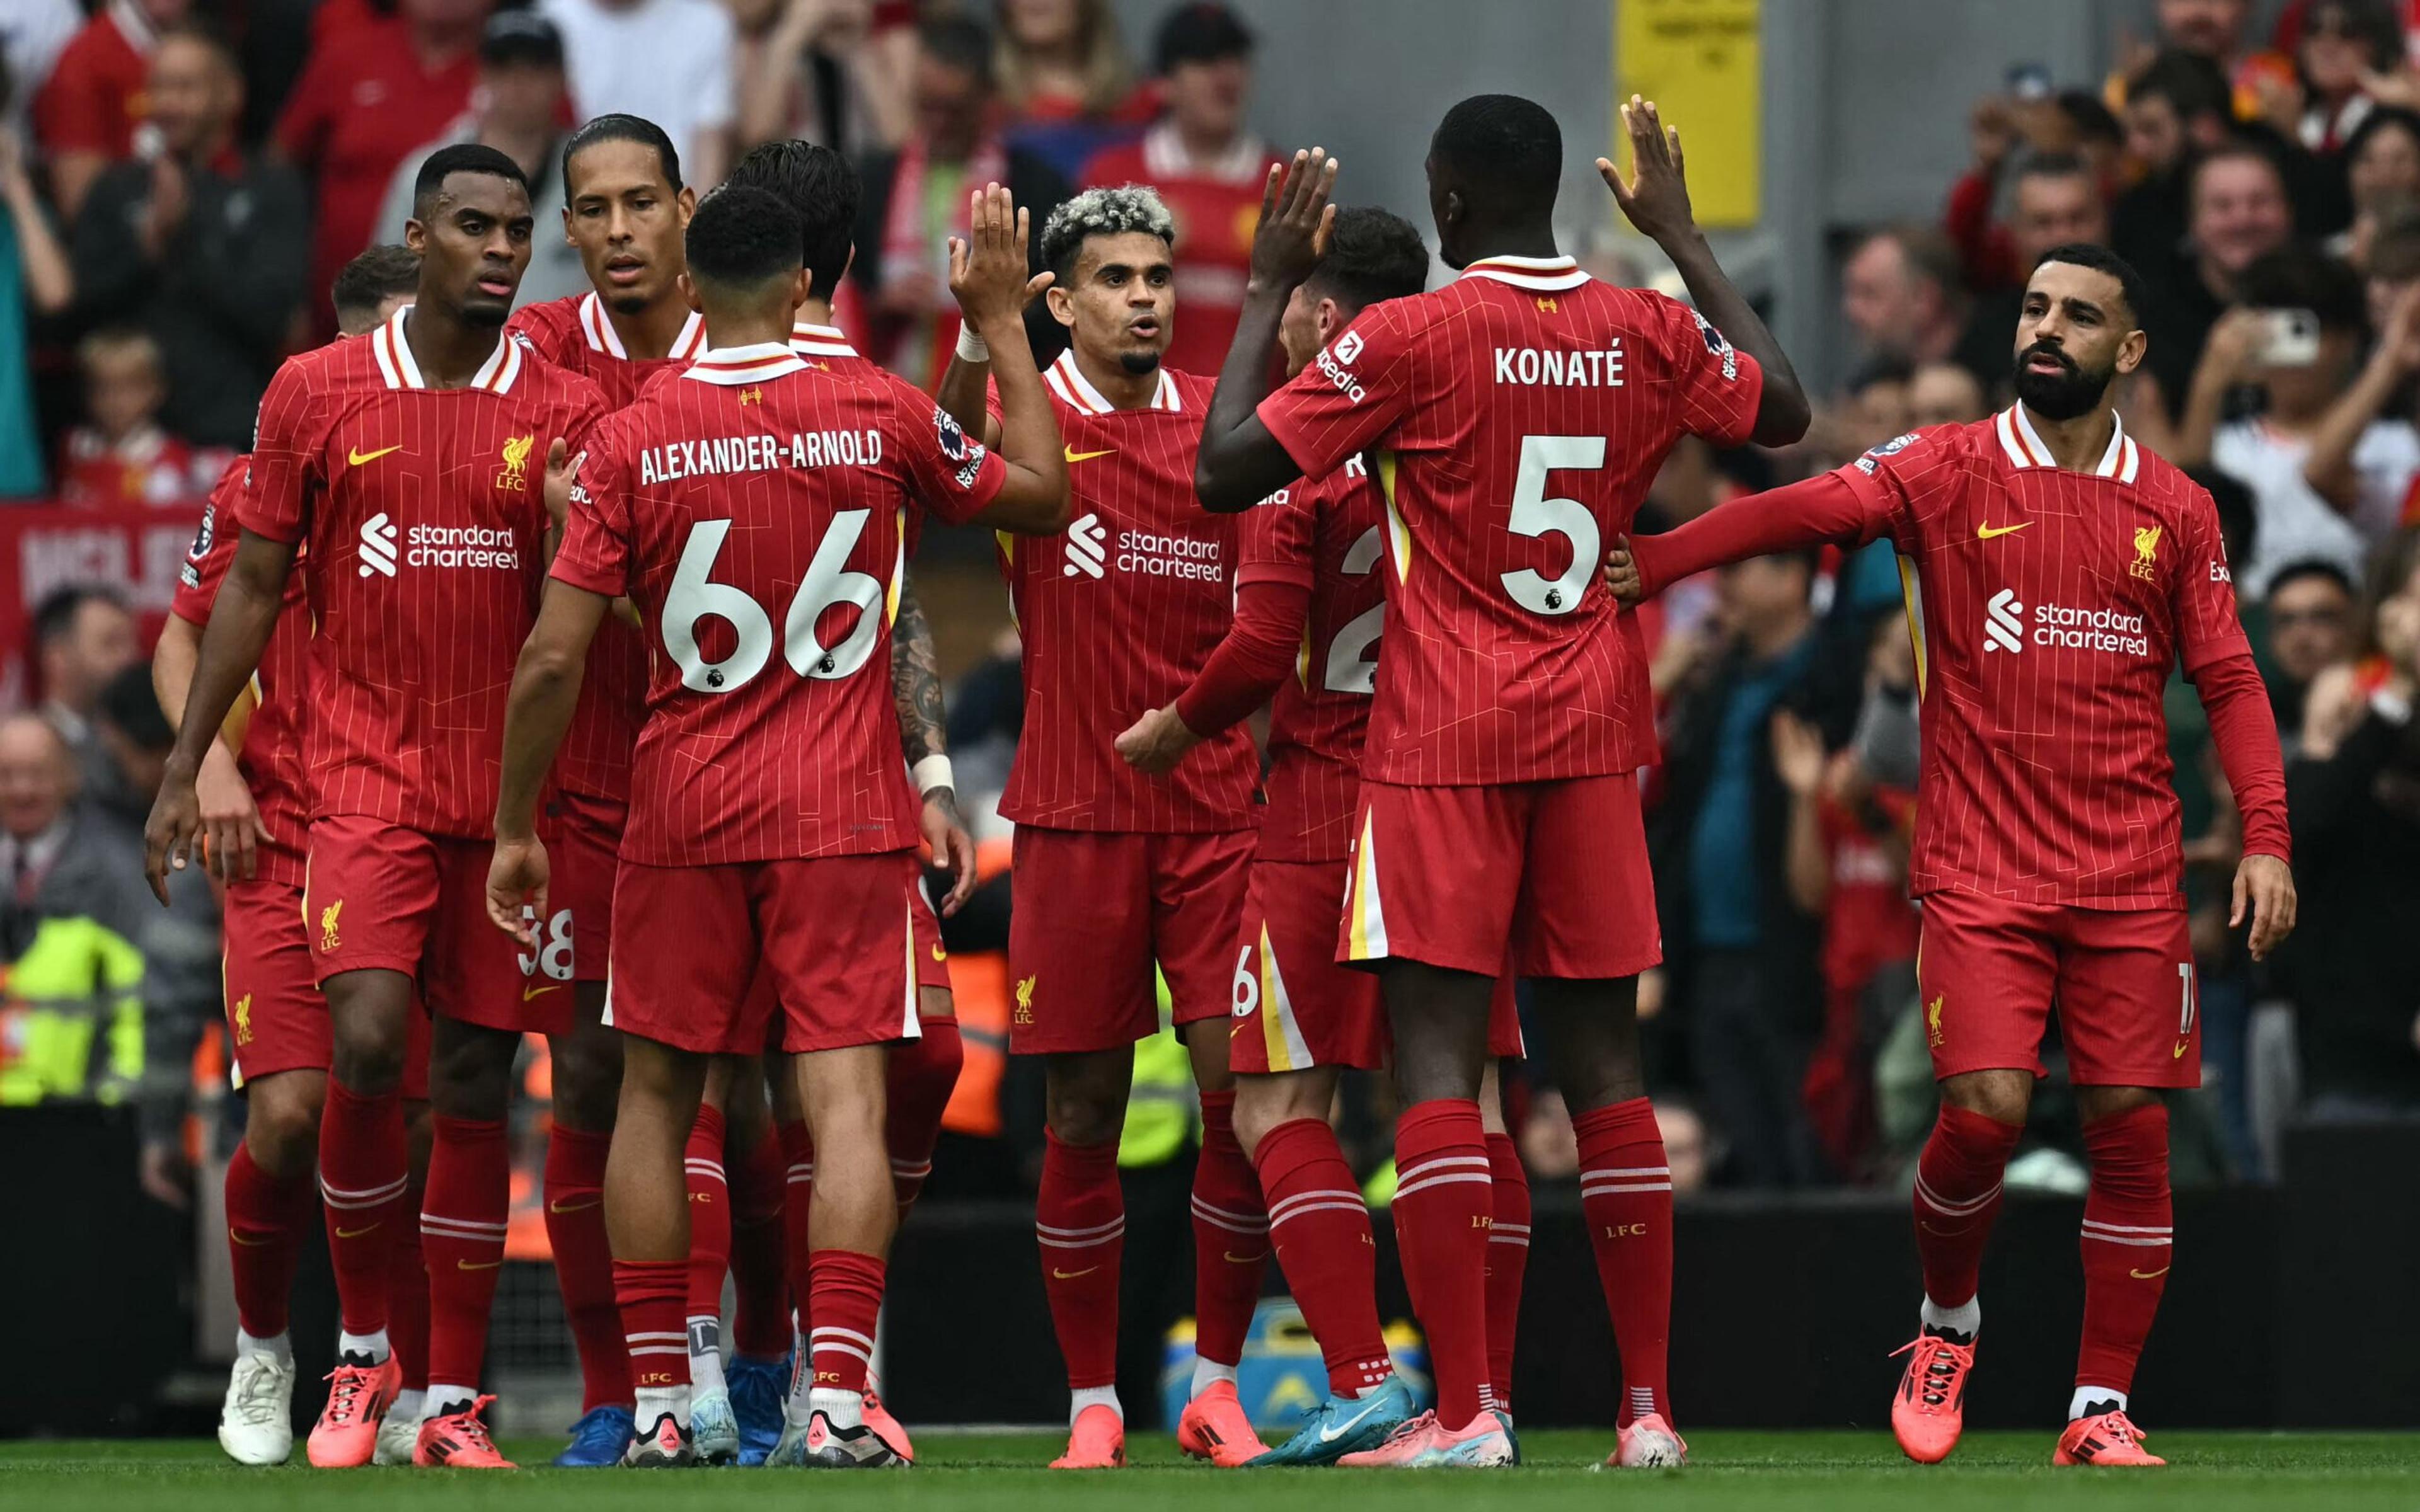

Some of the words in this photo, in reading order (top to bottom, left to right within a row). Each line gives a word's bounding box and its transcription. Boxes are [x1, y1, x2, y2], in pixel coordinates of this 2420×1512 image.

[1317, 347, 1366, 403] xpedia
[1495, 338, 1623, 386] KONATÉ
[642, 430, 882, 486] ALEXANDER-ARNOLD
[408, 523, 513, 548] standard
[1501, 435, 1607, 615] 5
[407, 545, 519, 570] chartered
[1118, 529, 1220, 560] standard
[1117, 551, 1223, 583] chartered
[661, 508, 883, 692] 66
[2034, 602, 2143, 634] standard
[2034, 625, 2148, 656] chartered
[1231, 945, 1259, 1017] 6
[2178, 963, 2195, 1034] 11
[688, 1193, 712, 1202] FC
[1605, 1223, 1647, 1239] LFC
[642, 1373, 672, 1384] LFC
[813, 1372, 840, 1383] LFC
